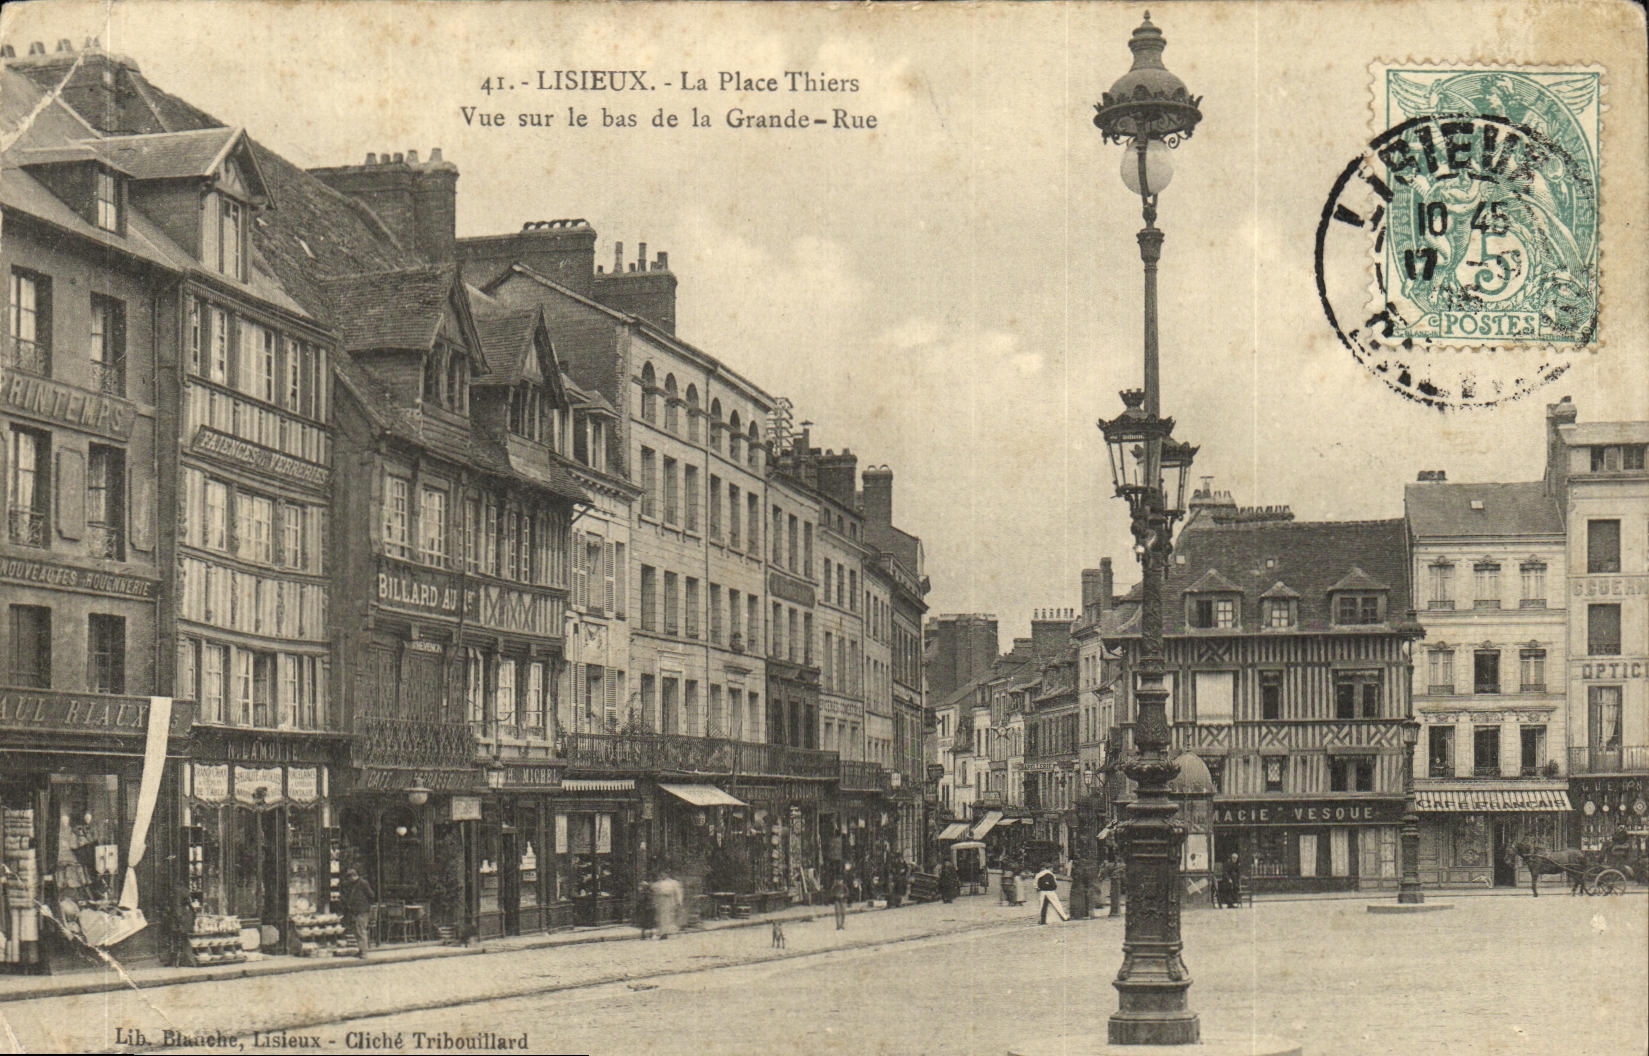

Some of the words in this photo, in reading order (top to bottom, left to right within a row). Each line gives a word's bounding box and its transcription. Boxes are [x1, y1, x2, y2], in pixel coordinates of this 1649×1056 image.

[1418, 202, 1448, 236] 10
[1443, 312, 1535, 337] POSTES
[378, 573, 438, 607] BILLARD
[442, 588, 457, 611] AU
[64, 700, 149, 728] RIAUX
[522, 768, 559, 785] MICHEL
[1294, 806, 1374, 821] VESQUE
